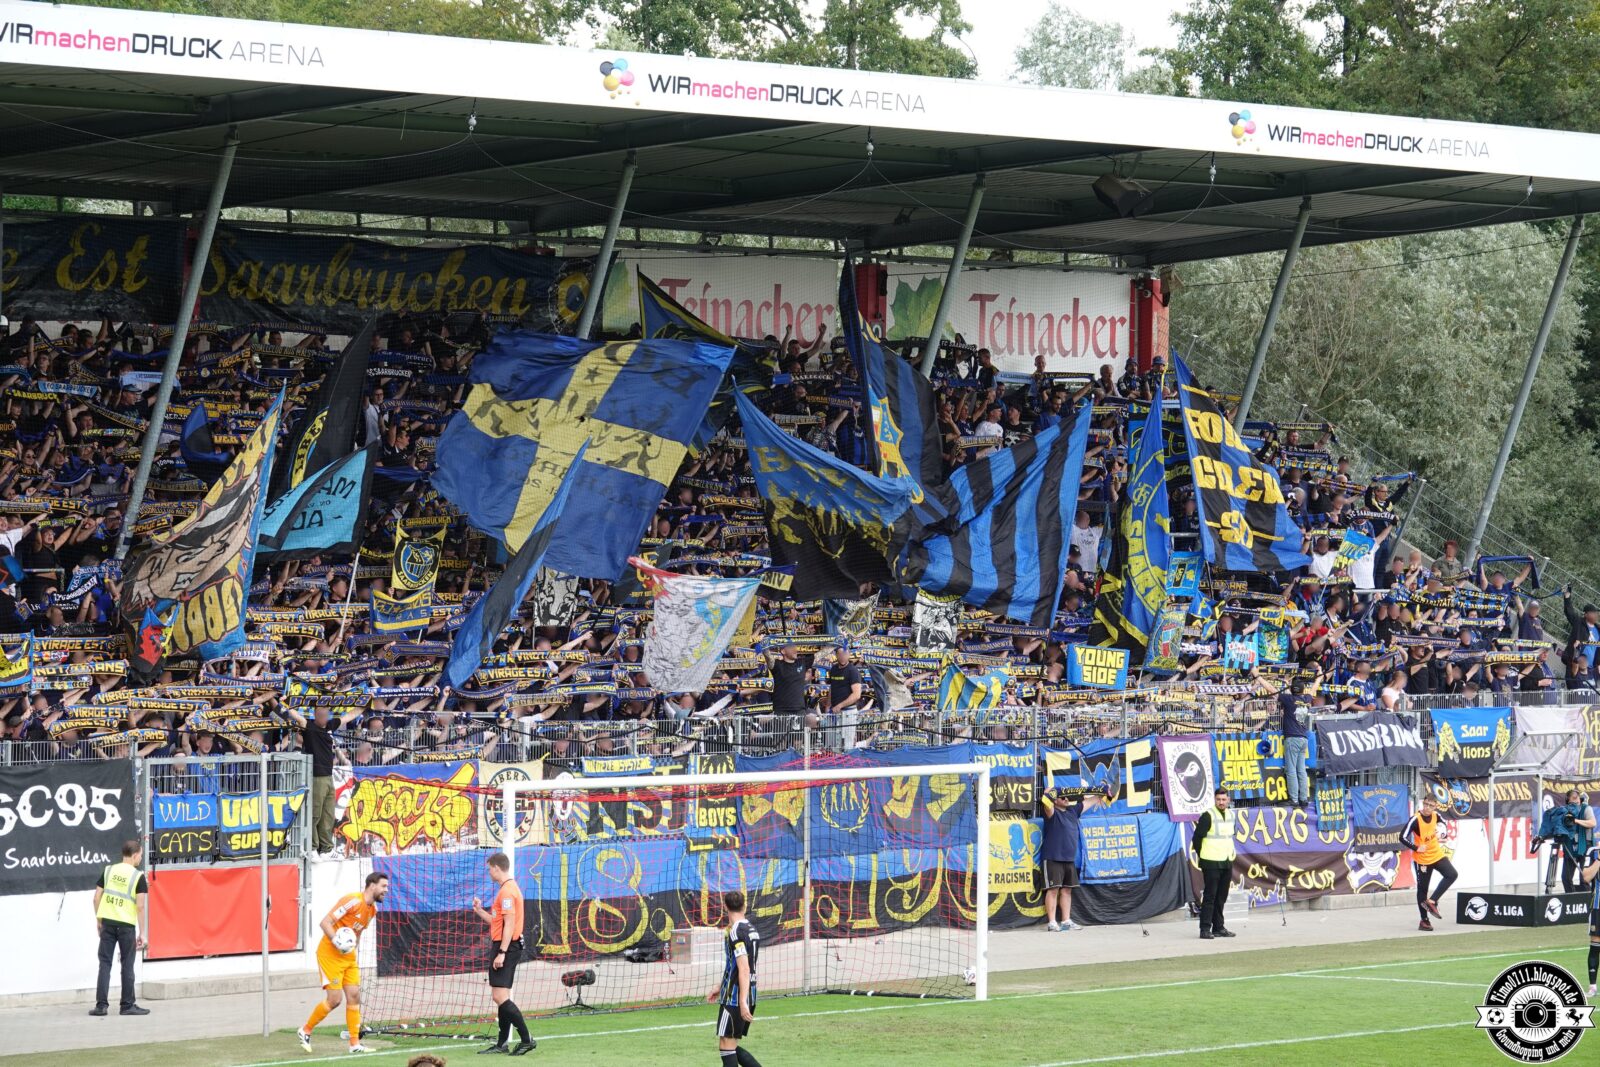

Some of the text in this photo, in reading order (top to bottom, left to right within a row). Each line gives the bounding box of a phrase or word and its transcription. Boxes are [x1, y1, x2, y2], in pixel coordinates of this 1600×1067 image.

[228, 42, 326, 69] ARENA
[648, 73, 926, 113] WIRmachenDRUCK ARENA
[1267, 123, 1490, 158] WIRmachenDRUCK ARENA
[199, 231, 533, 317] Saarbrücken
[968, 292, 1128, 360] Teinacher
[41, 639, 106, 651] VIRAGE EST
[1073, 645, 1126, 669] YOUNG
[1492, 652, 1540, 663] VIRAGE EST
[94, 660, 125, 675] ANS
[487, 667, 549, 679] VIRAGE EST
[1081, 664, 1119, 687] SIDE
[741, 679, 764, 690] EST
[97, 690, 133, 704] VIRAGE
[71, 707, 129, 719] VIRAGE EST
[1460, 724, 1489, 739] Saar
[1462, 746, 1491, 759] lions
[1221, 759, 1262, 782] SIDE
[159, 800, 211, 824] WILD
[698, 806, 738, 828] BOYS
[1090, 824, 1137, 837] SALZBURG
[1235, 806, 1309, 849] SARG
[158, 829, 213, 854] CATS
[1085, 835, 1136, 849] GIBT ES NUR
[3, 846, 111, 870] Saarbrücken
[1099, 847, 1139, 860] AUSTRIA
[111, 874, 128, 884] SDS
[993, 870, 1032, 885] RACISME
[1247, 863, 1336, 891] ON TOUR
[105, 895, 124, 908] 0418
[1572, 903, 1588, 914] LIGA
[1503, 905, 1524, 917] LIGA
